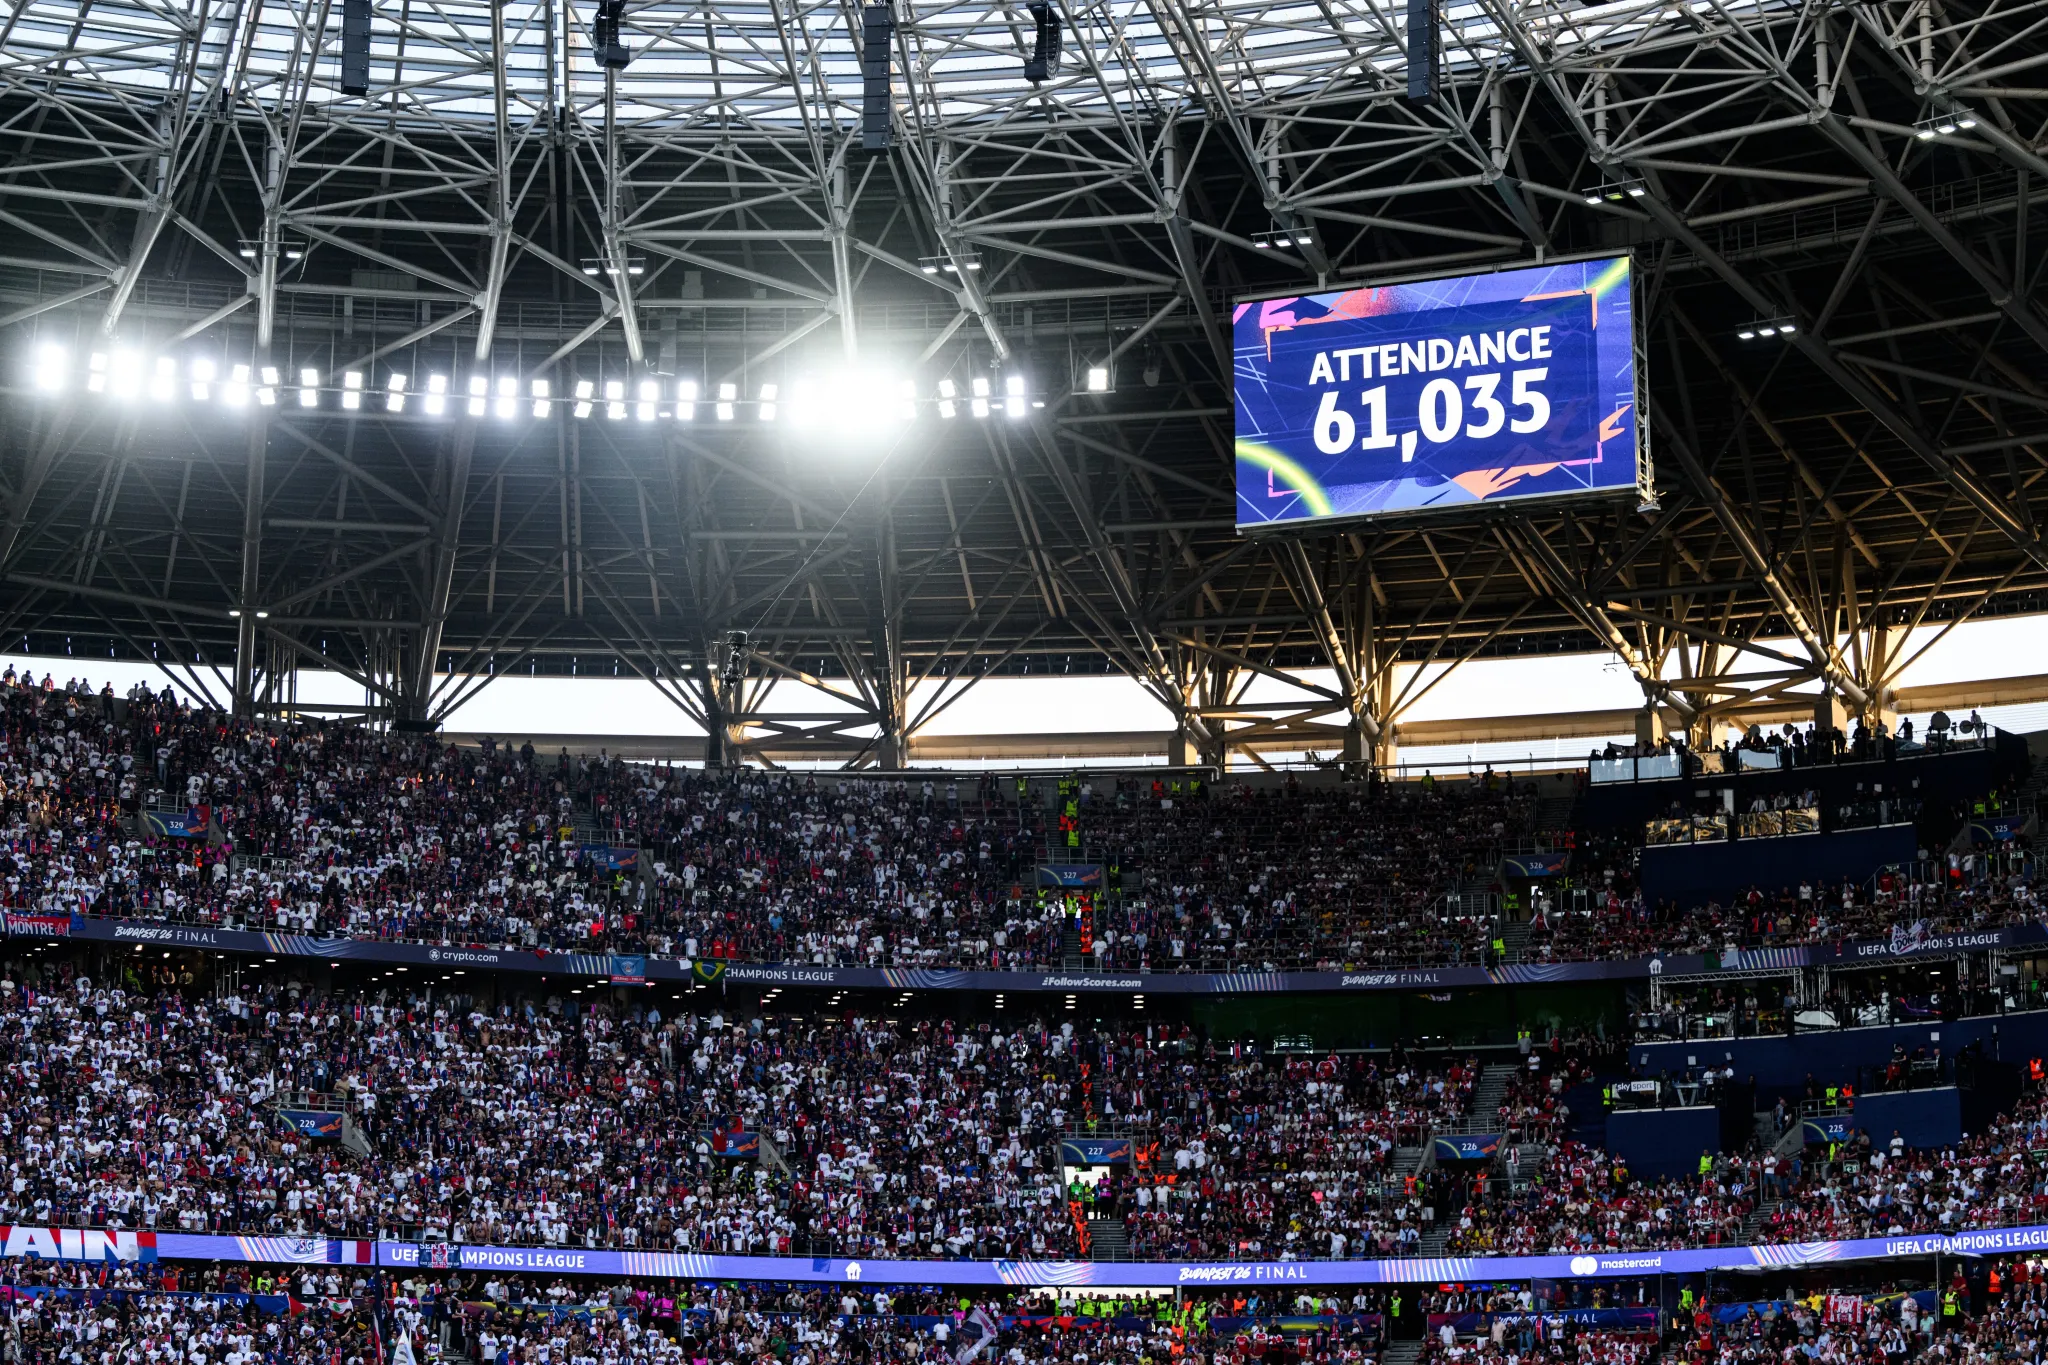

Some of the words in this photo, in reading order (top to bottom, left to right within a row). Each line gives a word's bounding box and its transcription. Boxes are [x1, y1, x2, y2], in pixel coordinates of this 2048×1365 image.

[1309, 325, 1553, 386] ATTENDANCE
[1313, 367, 1551, 463] 61,035
[169, 819, 185, 829] 329
[1994, 824, 2008, 834] 325
[1529, 861, 1544, 870] 326
[1062, 871, 1078, 881] 327
[7, 920, 72, 938] MONTREAL
[115, 926, 160, 939] BUDAPEST
[159, 929, 173, 940] 26
[176, 930, 217, 944] FINAL
[1858, 944, 1887, 956] UEFA
[1957, 933, 2001, 947] LEAGUE
[442, 951, 499, 963] crypto.com
[724, 967, 788, 980] CHAMPIONS
[791, 971, 834, 982] LEAGUE
[1341, 974, 1385, 987] BUDAPEST
[1384, 974, 1398, 985] 26
[1400, 973, 1440, 984] FINAL
[1047, 977, 1143, 988] FollowScores.com
[1617, 1083, 1631, 1091] sky
[1632, 1083, 1653, 1091] sport
[299, 1119, 316, 1130] 229
[1827, 1124, 1844, 1134] 225
[1088, 1147, 1106, 1157] 227
[1461, 1143, 1479, 1154] 226
[294, 1239, 314, 1253] PSG
[1886, 1240, 1922, 1255] UEFA
[1923, 1233, 2003, 1252] CHAMPIONS
[391, 1247, 421, 1262] UEF
[527, 1254, 586, 1268] LEAGUE
[1601, 1256, 1662, 1269] mastercard
[1178, 1267, 1236, 1281] BUDAPEST
[1233, 1266, 1252, 1279] 26
[1256, 1266, 1308, 1279] FINAL
